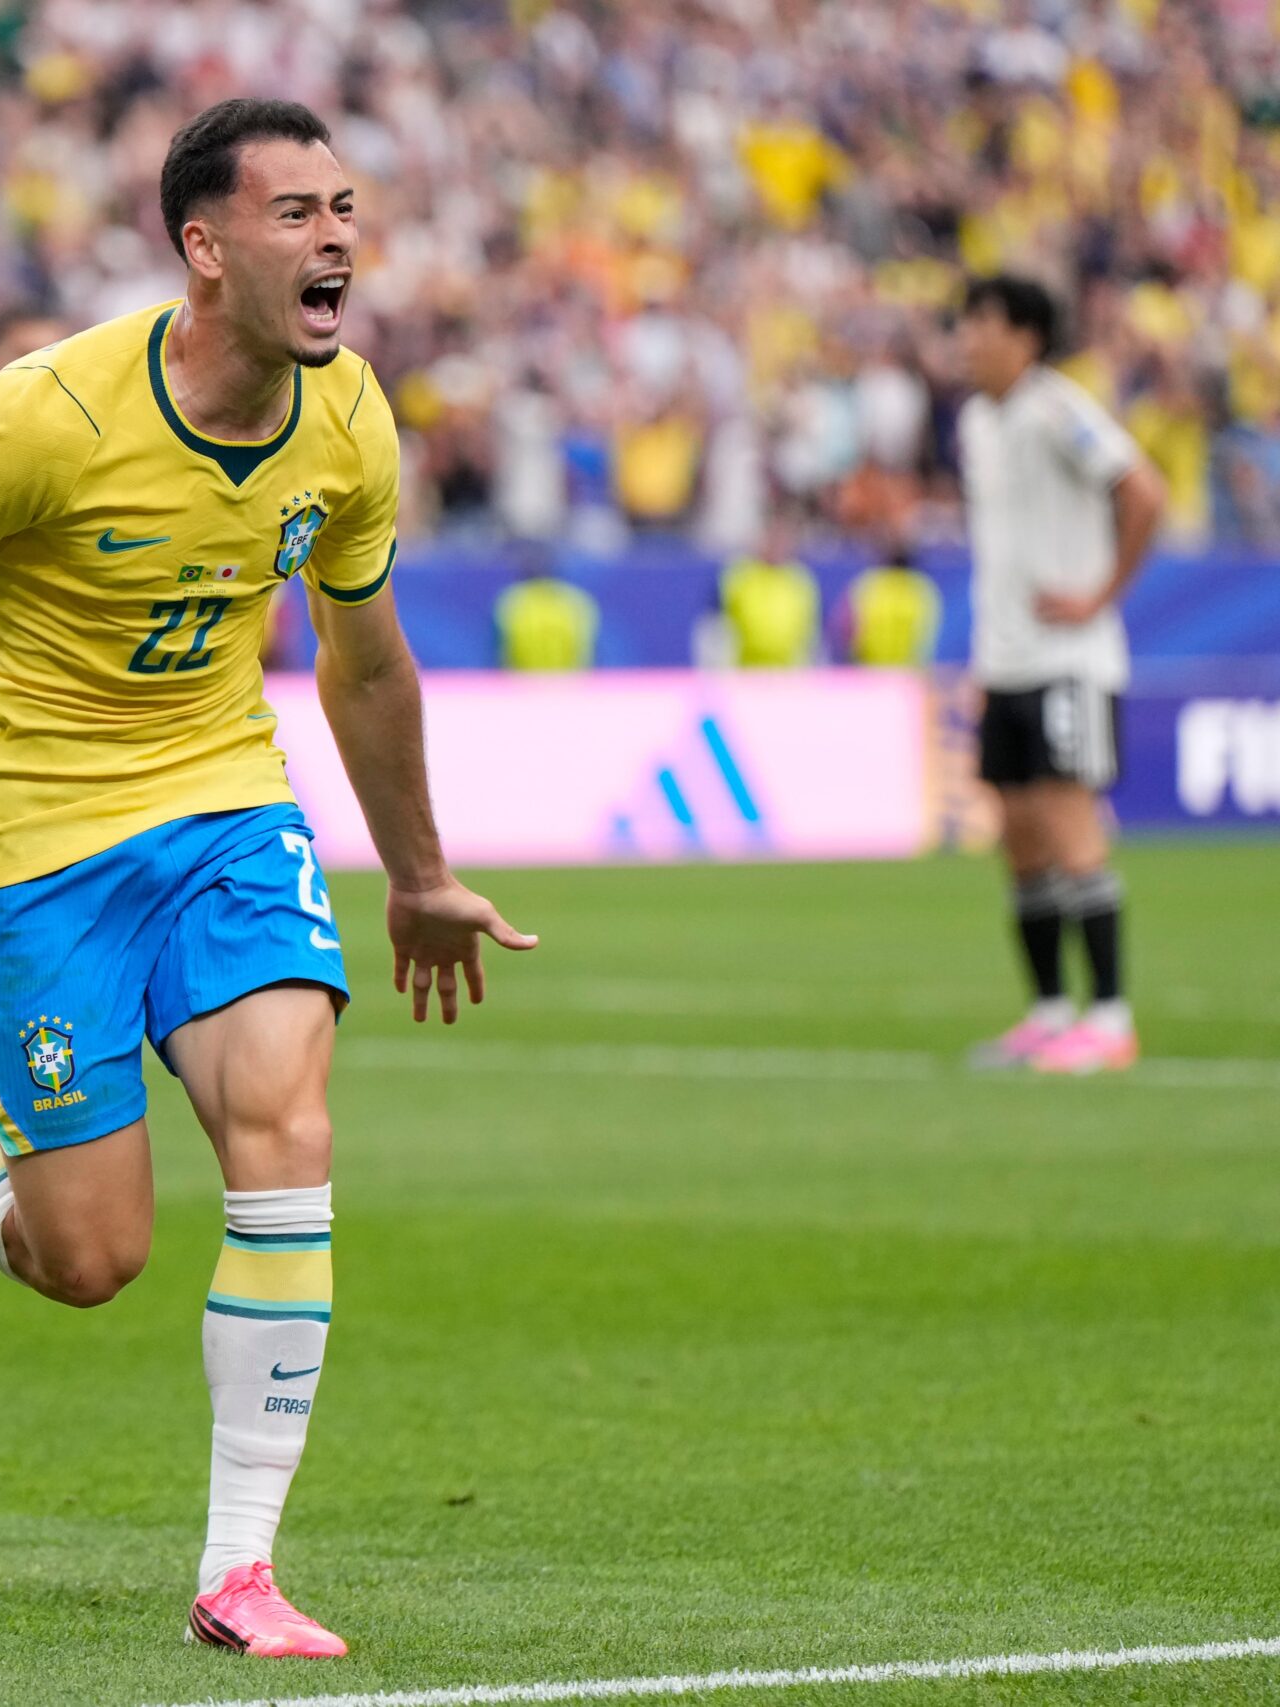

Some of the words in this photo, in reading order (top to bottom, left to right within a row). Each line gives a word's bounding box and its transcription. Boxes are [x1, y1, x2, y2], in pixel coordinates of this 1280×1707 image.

[291, 534, 309, 546] CBF
[128, 598, 232, 673] 22
[40, 1053, 59, 1063] CBF
[33, 1090, 87, 1112] BRASIL
[264, 1396, 311, 1414] BRASI
